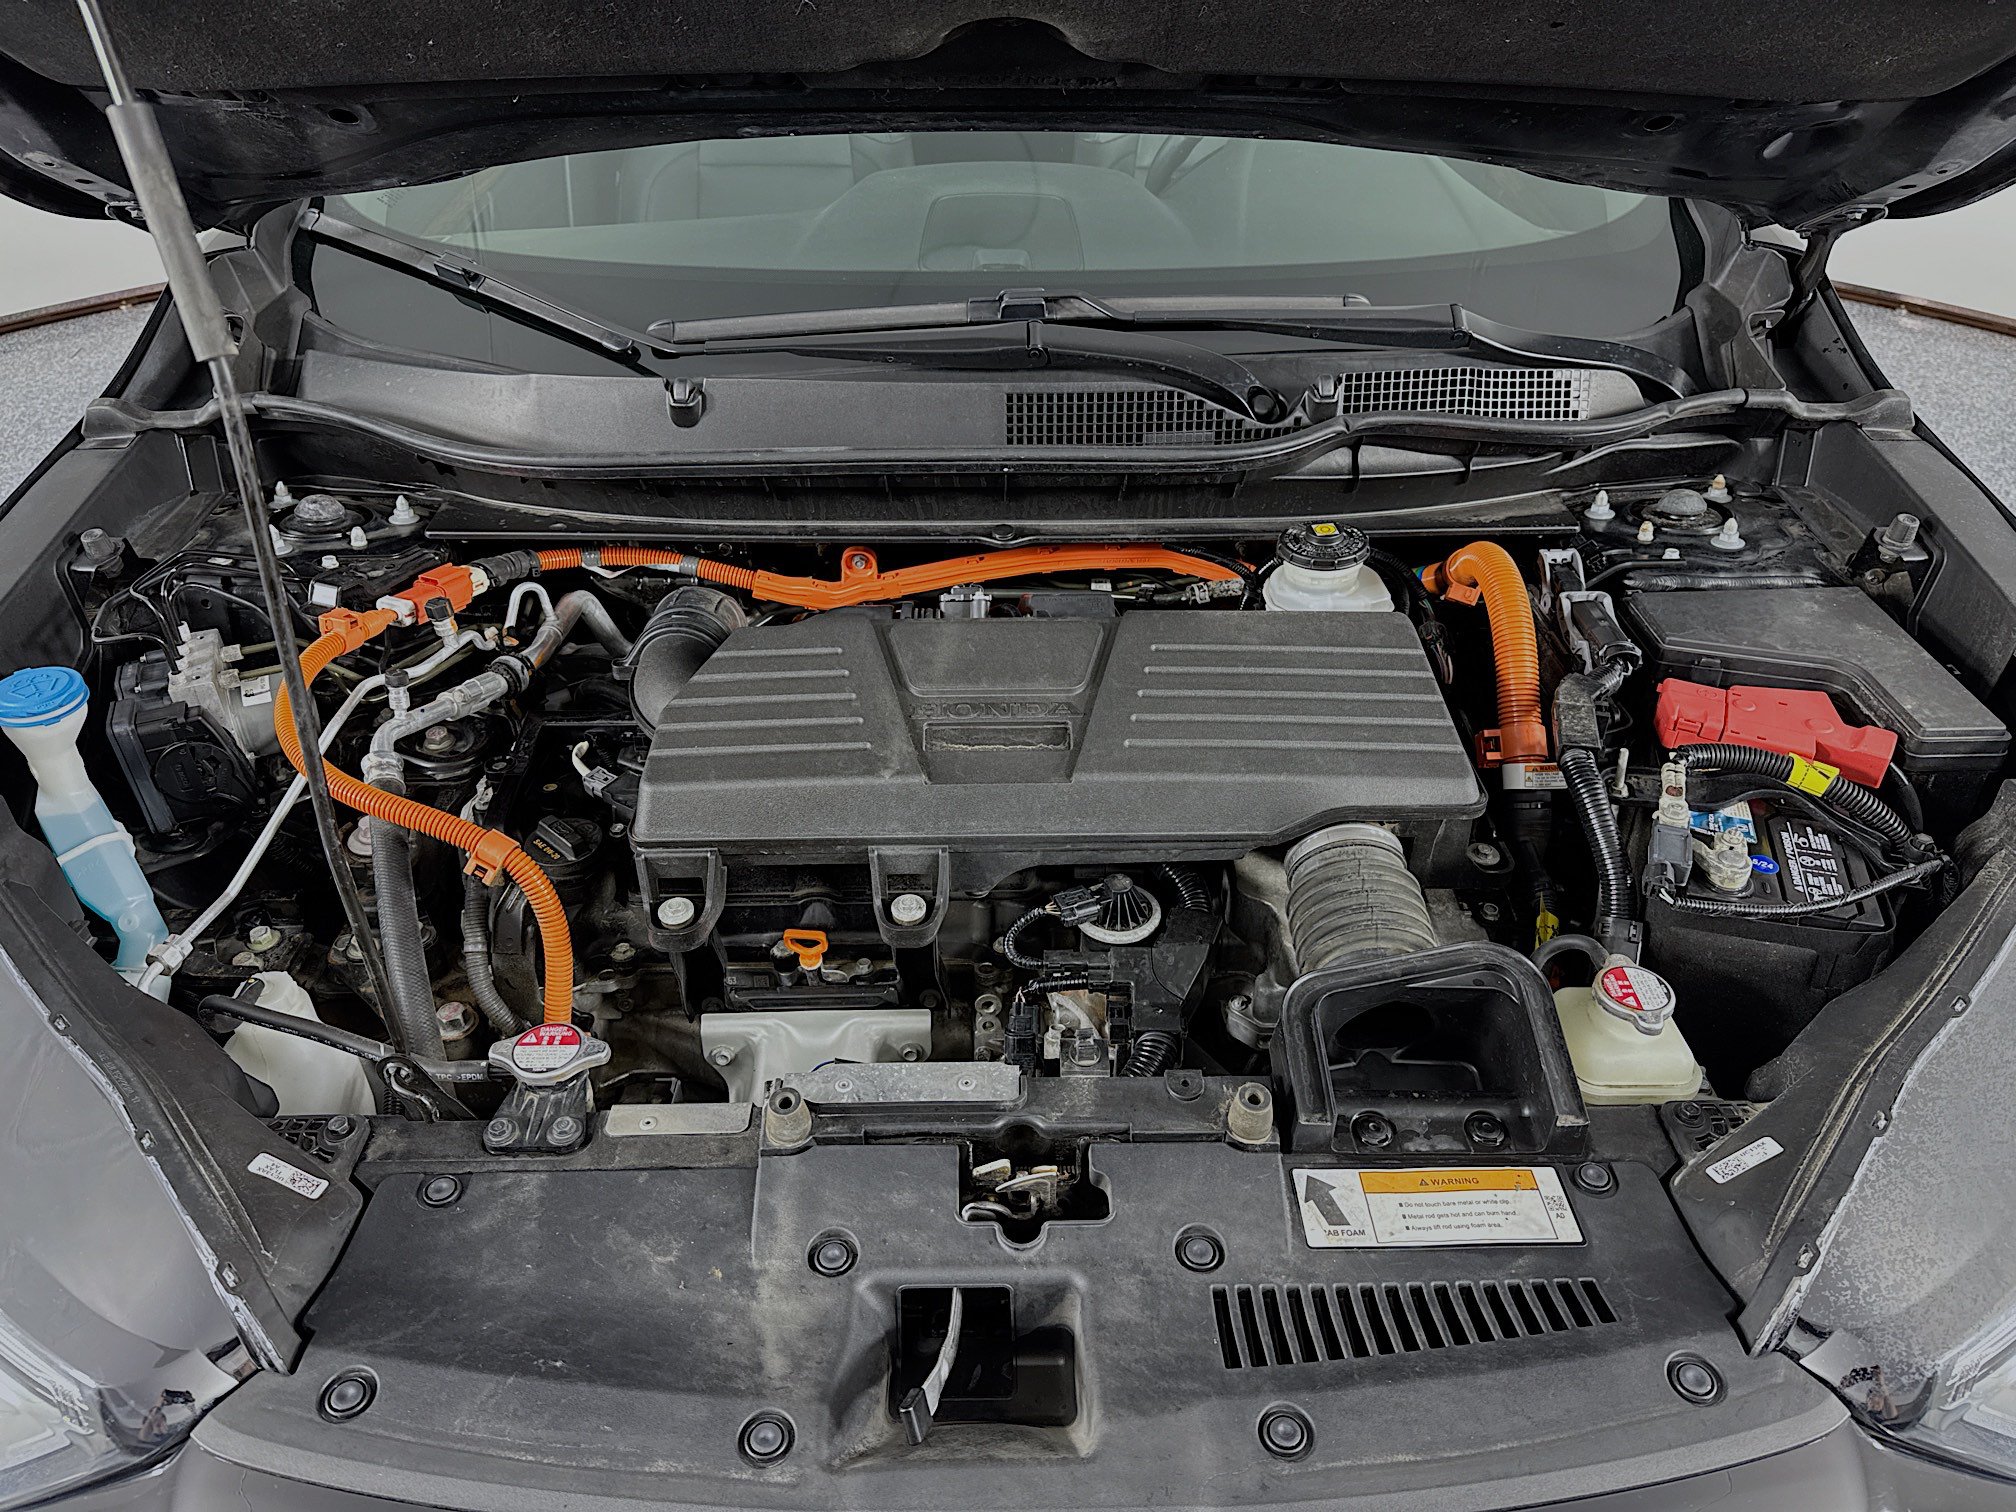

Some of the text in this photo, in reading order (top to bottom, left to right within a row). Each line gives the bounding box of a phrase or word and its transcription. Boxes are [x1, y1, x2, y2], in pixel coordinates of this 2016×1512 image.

[909, 702, 1086, 719] HONDA
[1430, 1177, 1480, 1186] WARNING
[1340, 1229, 1367, 1237] FOAM
